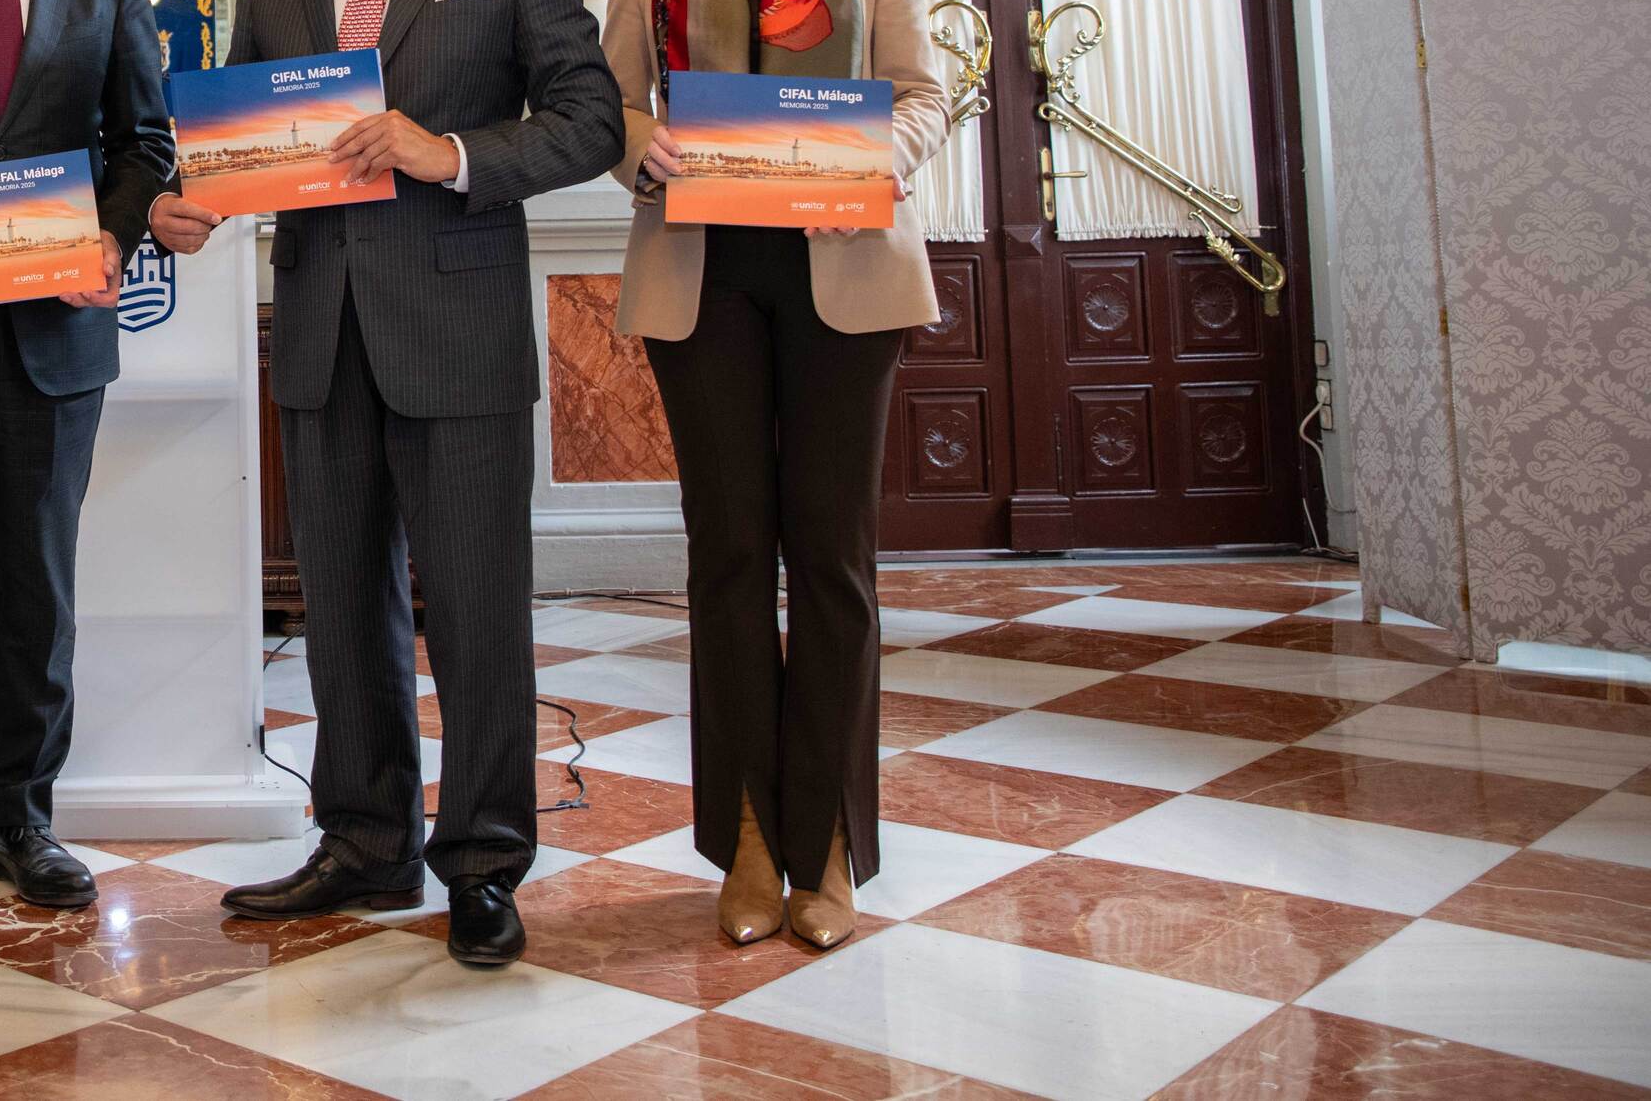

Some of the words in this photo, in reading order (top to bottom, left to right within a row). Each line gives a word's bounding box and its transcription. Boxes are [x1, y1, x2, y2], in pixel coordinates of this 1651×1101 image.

[271, 70, 305, 84] CIFAL
[307, 66, 351, 78] Málaga
[272, 84, 304, 93] MEMORIA
[779, 88, 814, 99] CIFAL
[817, 90, 863, 104] Málaga
[779, 101, 812, 109] MEMORIA
[812, 102, 829, 110] 2025
[23, 166, 65, 178] Málaga
[20, 181, 36, 189] 2025
